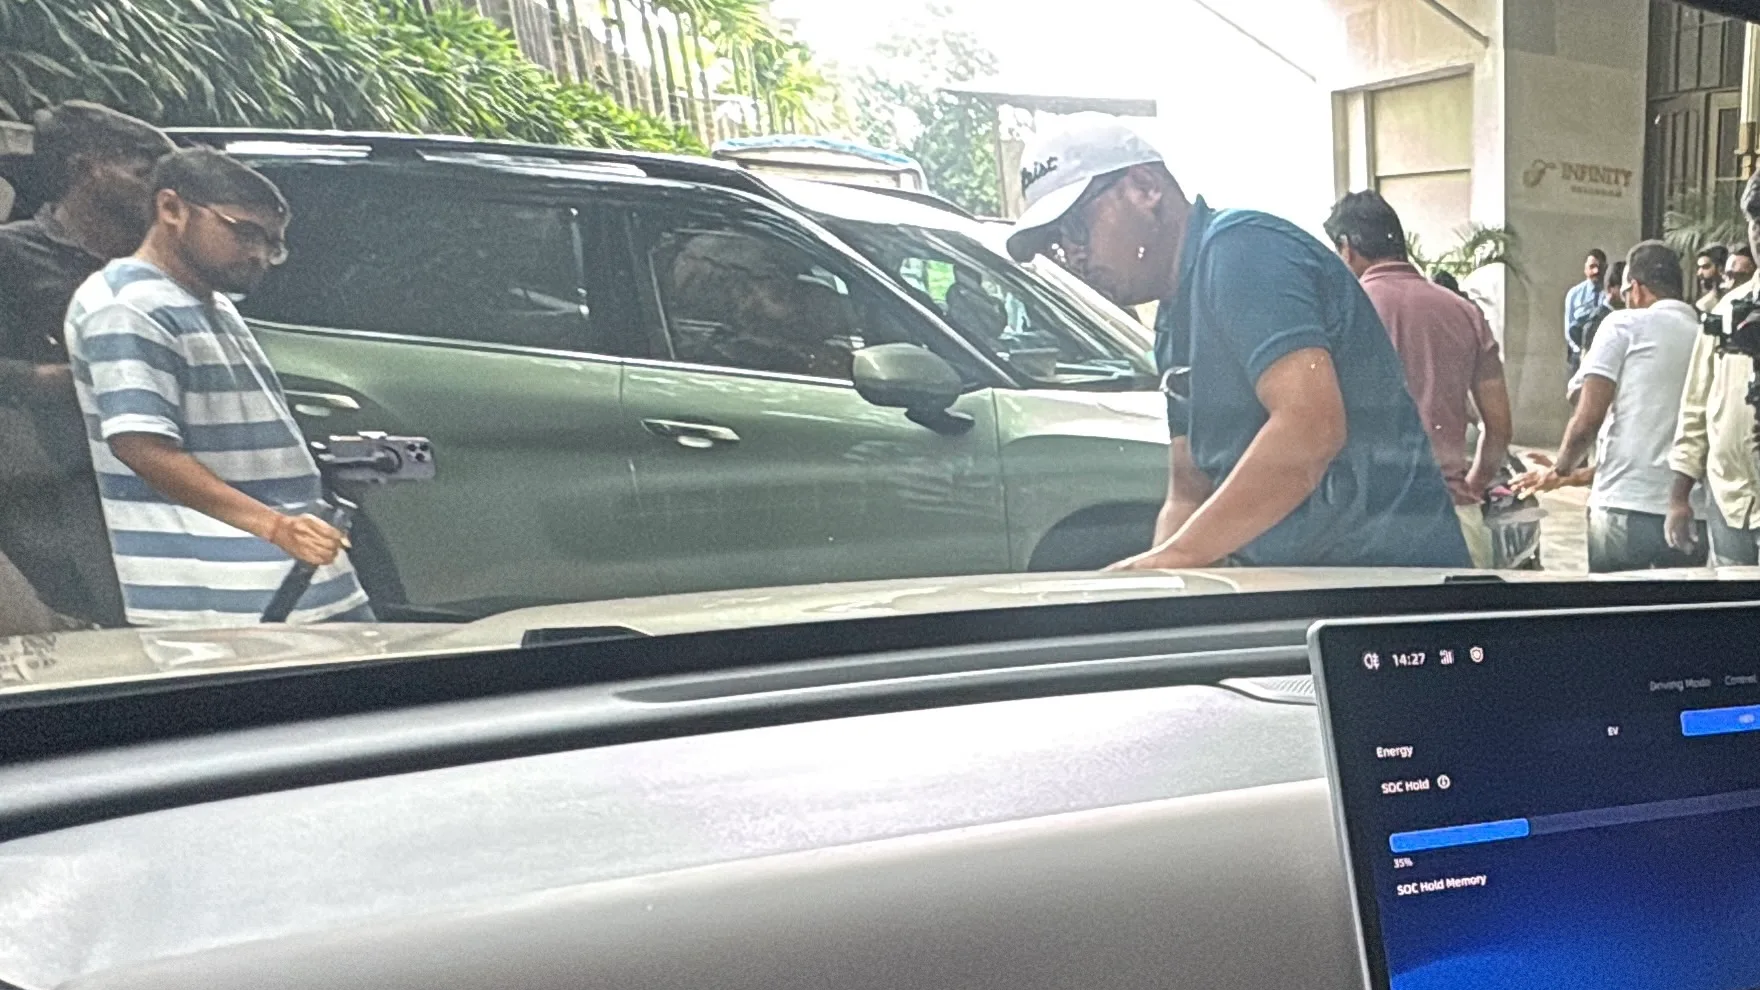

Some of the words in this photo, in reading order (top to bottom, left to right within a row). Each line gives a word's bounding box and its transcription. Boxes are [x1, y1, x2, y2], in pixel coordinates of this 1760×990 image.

[1561, 161, 1632, 188] INFINITY
[1392, 652, 1426, 667] 14:27
[1376, 746, 1413, 758] Energy
[1381, 780, 1403, 794] SOC
[1405, 778, 1430, 791] Hold
[1393, 857, 1413, 869] 35%
[1396, 883, 1419, 896] SOC
[1420, 878, 1445, 893] Hold
[1445, 874, 1487, 890] Memory
